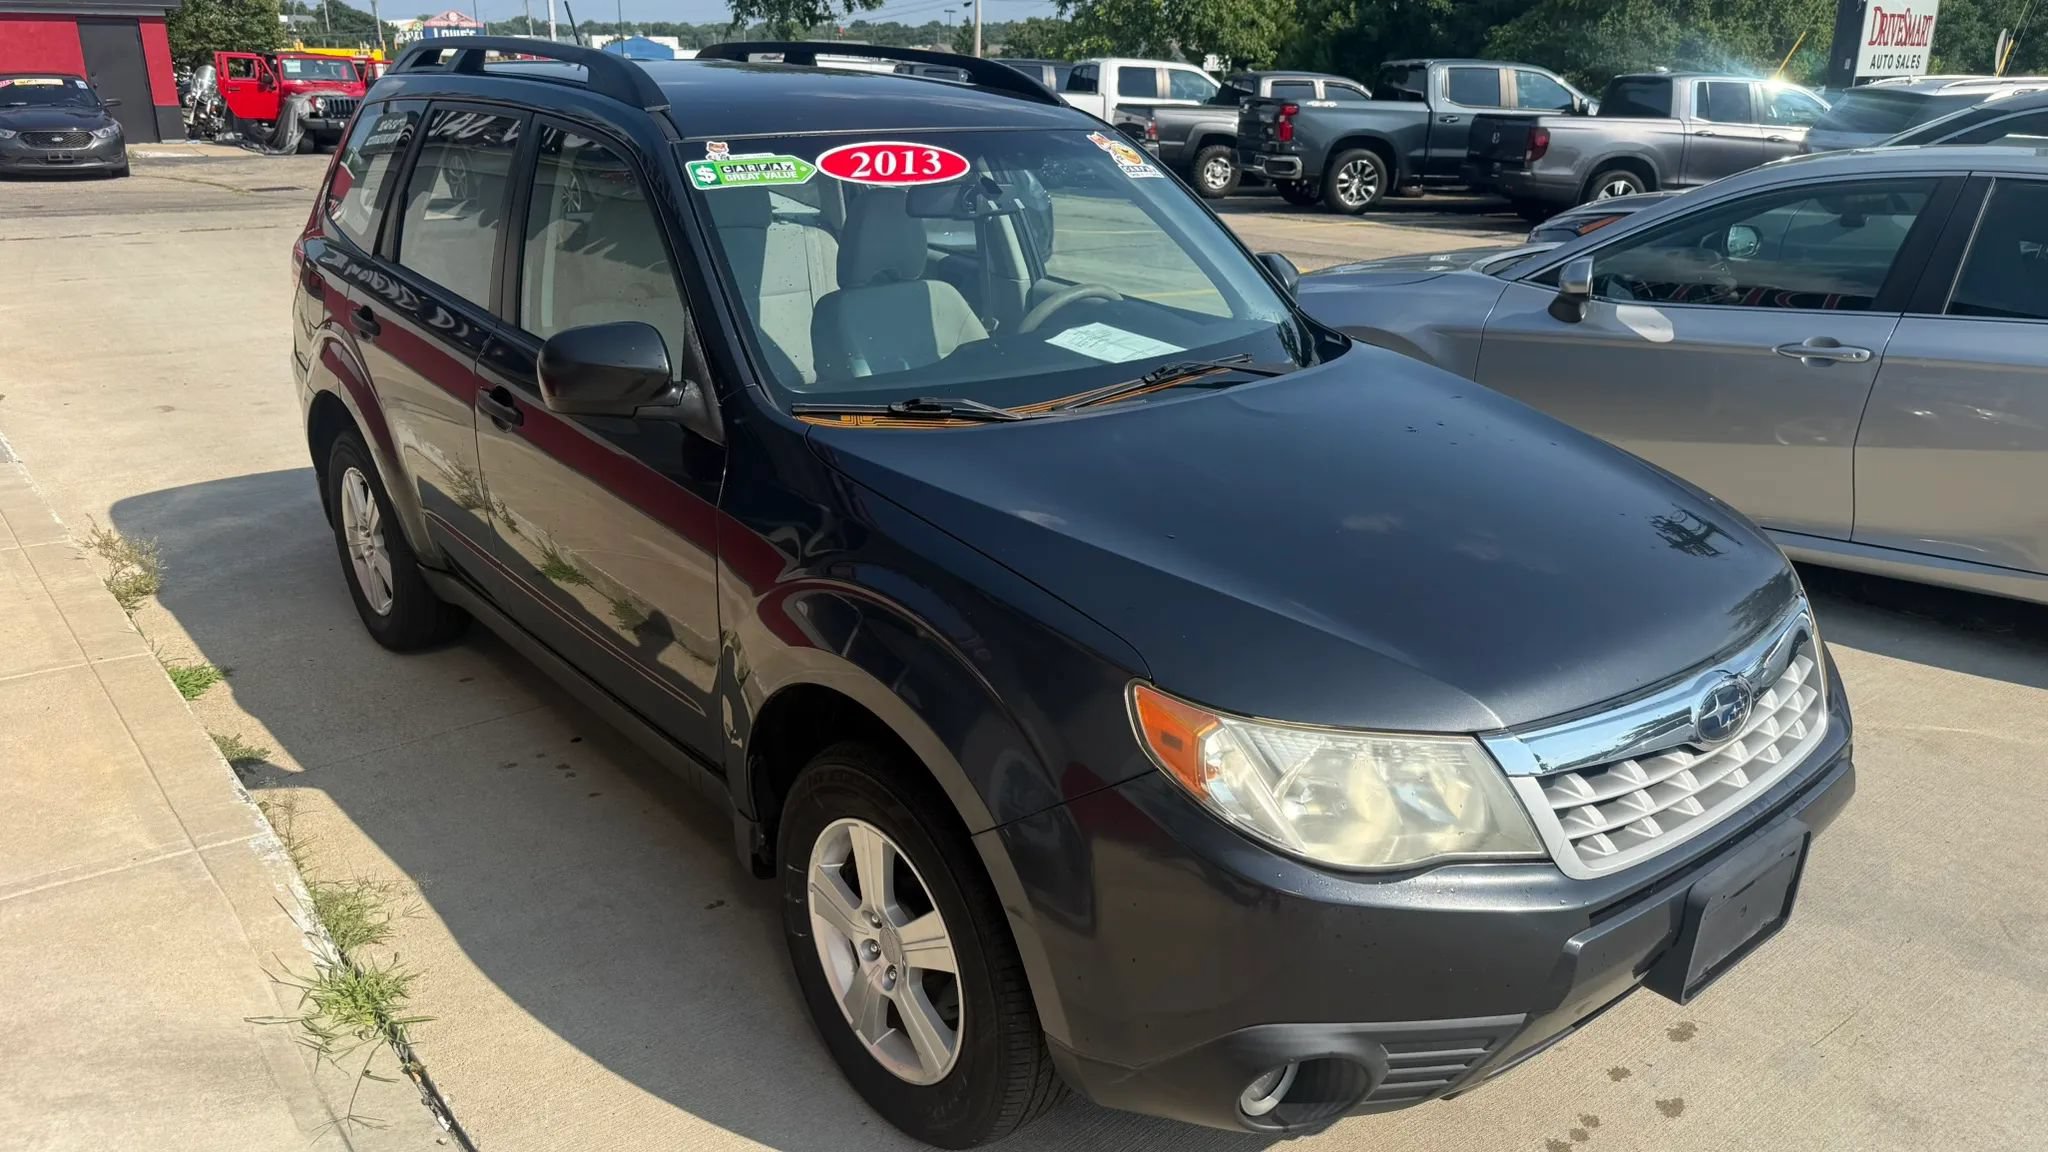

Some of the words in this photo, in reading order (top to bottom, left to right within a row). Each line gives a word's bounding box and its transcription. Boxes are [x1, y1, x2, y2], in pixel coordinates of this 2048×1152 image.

[1870, 54, 1893, 69] AUTO
[1895, 54, 1921, 69] SALES
[721, 161, 796, 173] CARFAX
[850, 150, 942, 178] 2013
[725, 170, 760, 181] GREAT
[763, 168, 798, 180] VALUE
